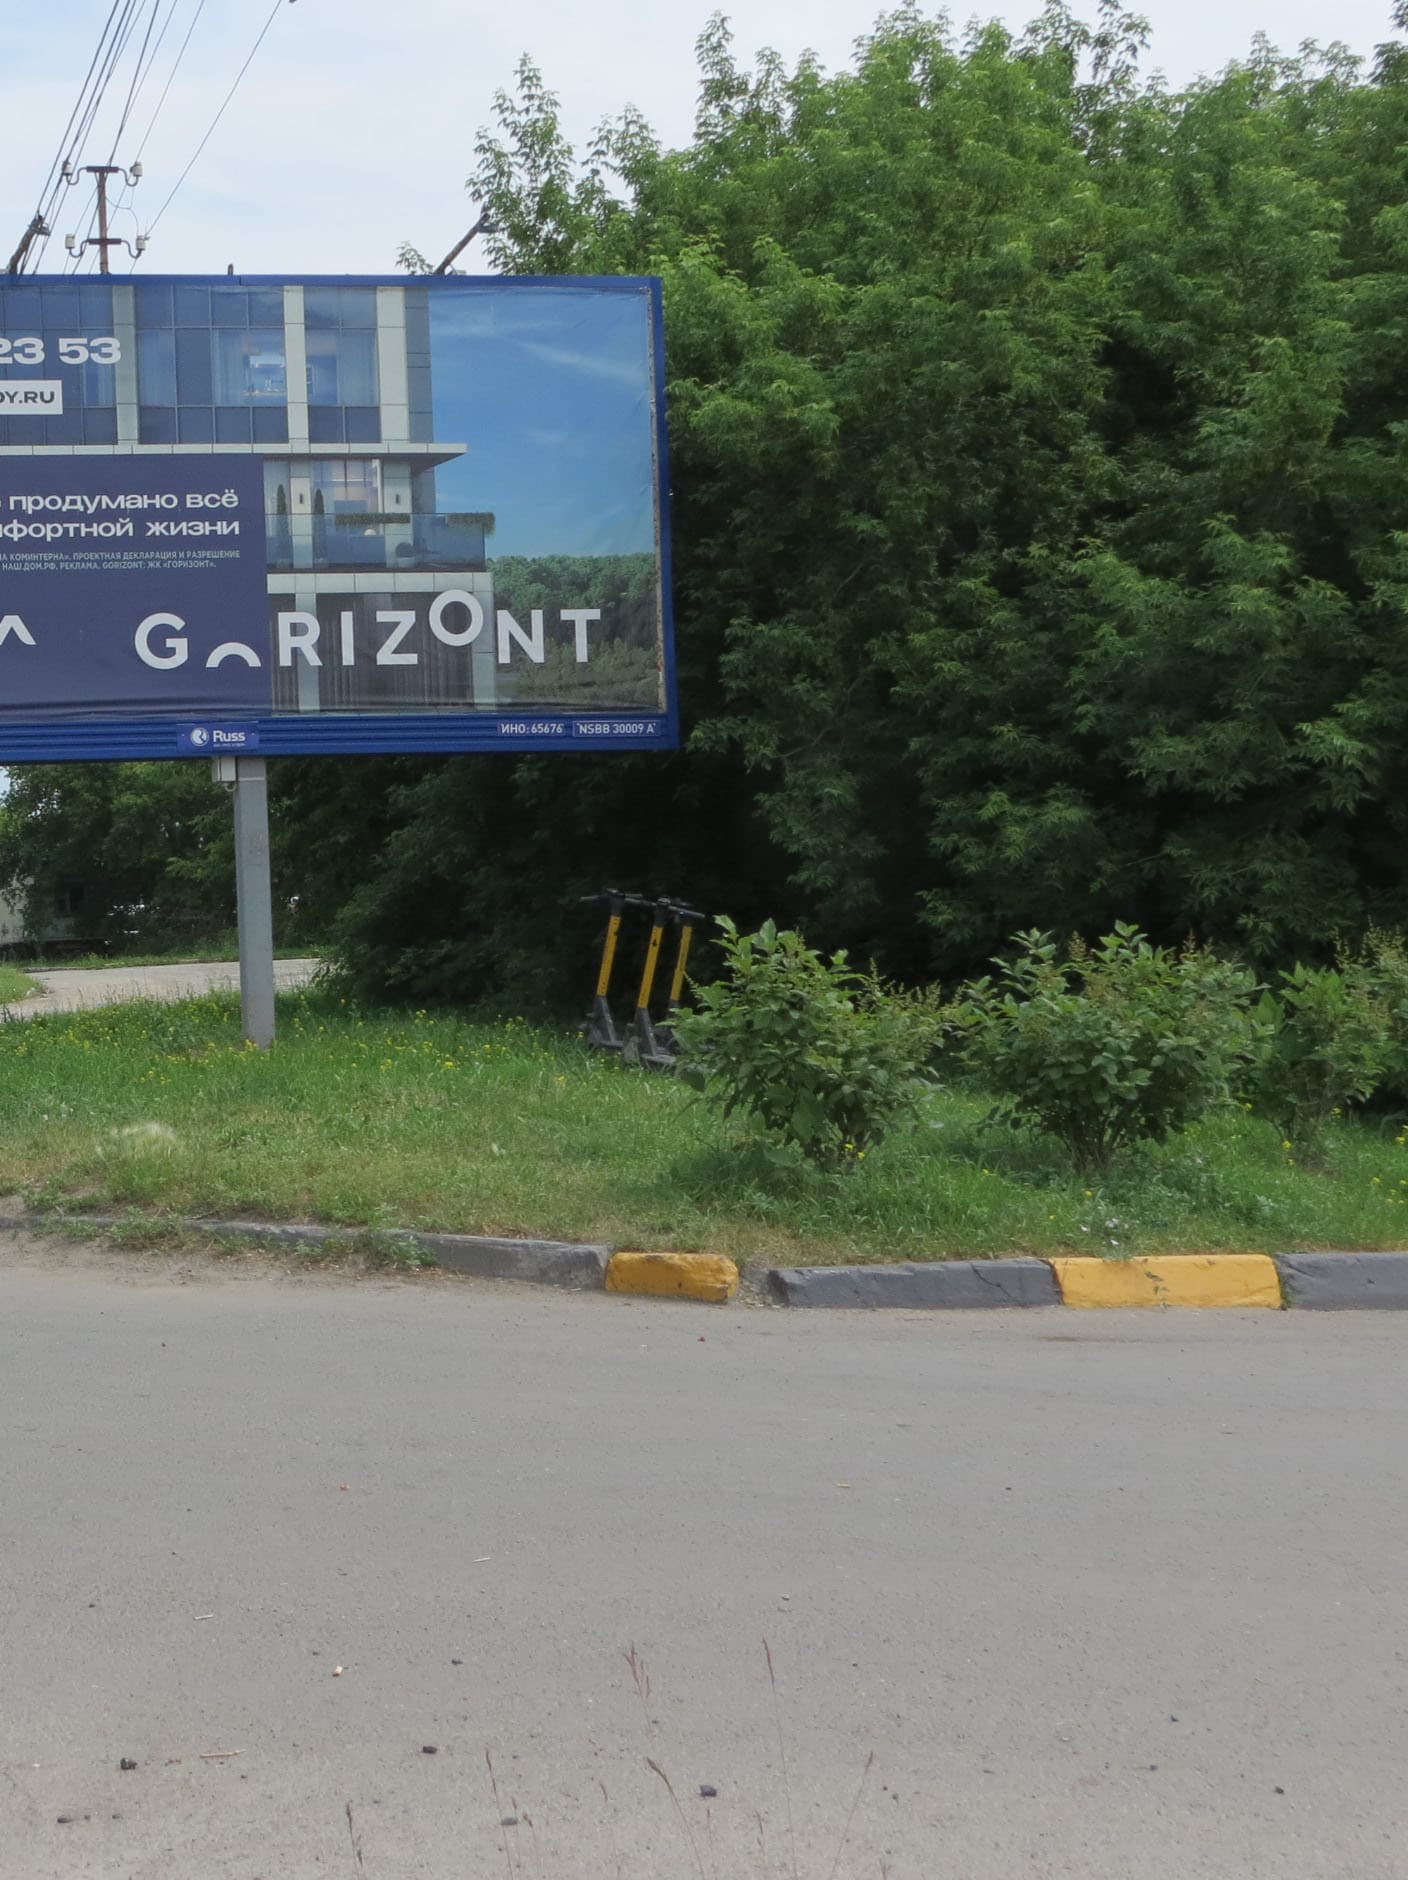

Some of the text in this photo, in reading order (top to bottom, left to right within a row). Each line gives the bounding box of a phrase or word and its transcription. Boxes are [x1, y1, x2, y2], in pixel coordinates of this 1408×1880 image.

[58, 336, 122, 365] 53
[9, 493, 179, 514] продумано
[185, 489, 239, 509] всё
[145, 520, 240, 537] жизни
[73, 551, 122, 560] ПРОЕКТНАЯ
[123, 551, 177, 561] ДЕКЛАРАЦИЯ
[178, 550, 185, 559] И
[186, 550, 241, 559] РАЗРЕШЕНИЕ
[147, 560, 162, 569] ЖК
[612, 722, 644, 734] 30009
[213, 730, 246, 743] Russ
